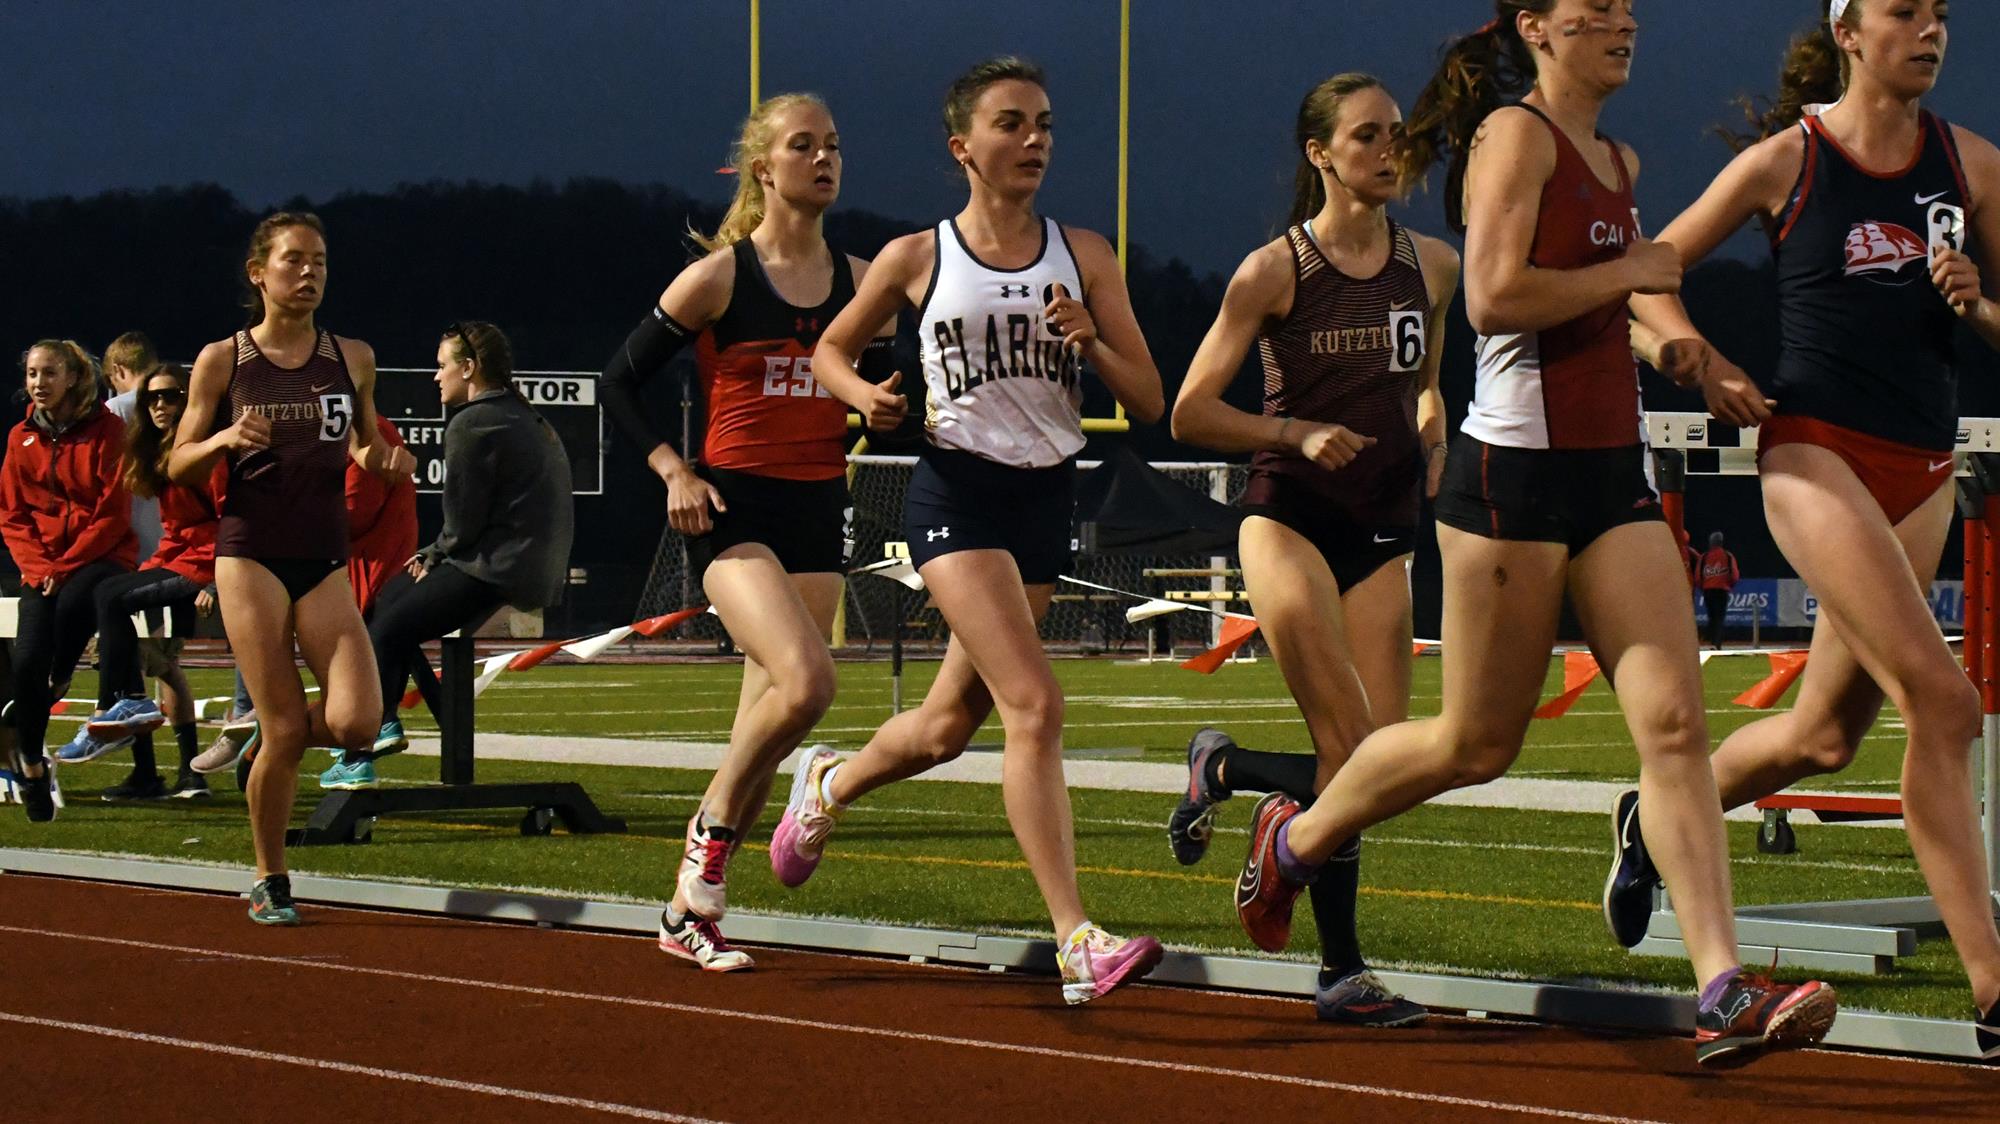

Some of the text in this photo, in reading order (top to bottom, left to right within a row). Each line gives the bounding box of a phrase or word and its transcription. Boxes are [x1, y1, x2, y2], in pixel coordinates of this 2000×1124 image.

[1932, 208, 1957, 258] 3
[1396, 315, 1420, 368] 6
[325, 397, 347, 438] 5
